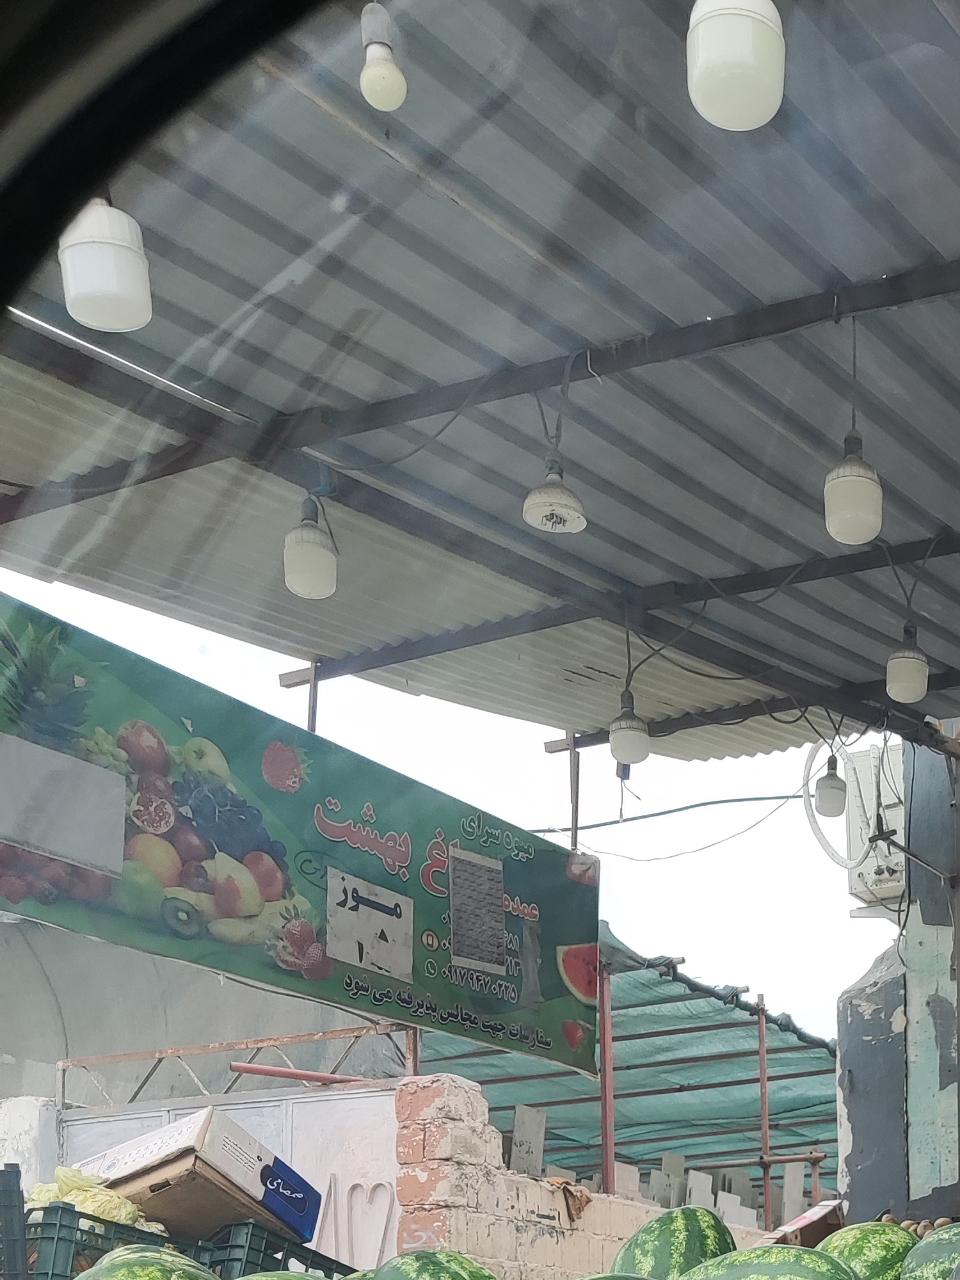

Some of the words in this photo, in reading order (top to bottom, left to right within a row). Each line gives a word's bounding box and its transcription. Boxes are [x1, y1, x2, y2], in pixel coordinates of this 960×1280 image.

[315, 796, 410, 883] بهشت
[460, 811, 501, 847] سرای
[503, 831, 534, 862] میوه
[336, 876, 402, 919] موز
